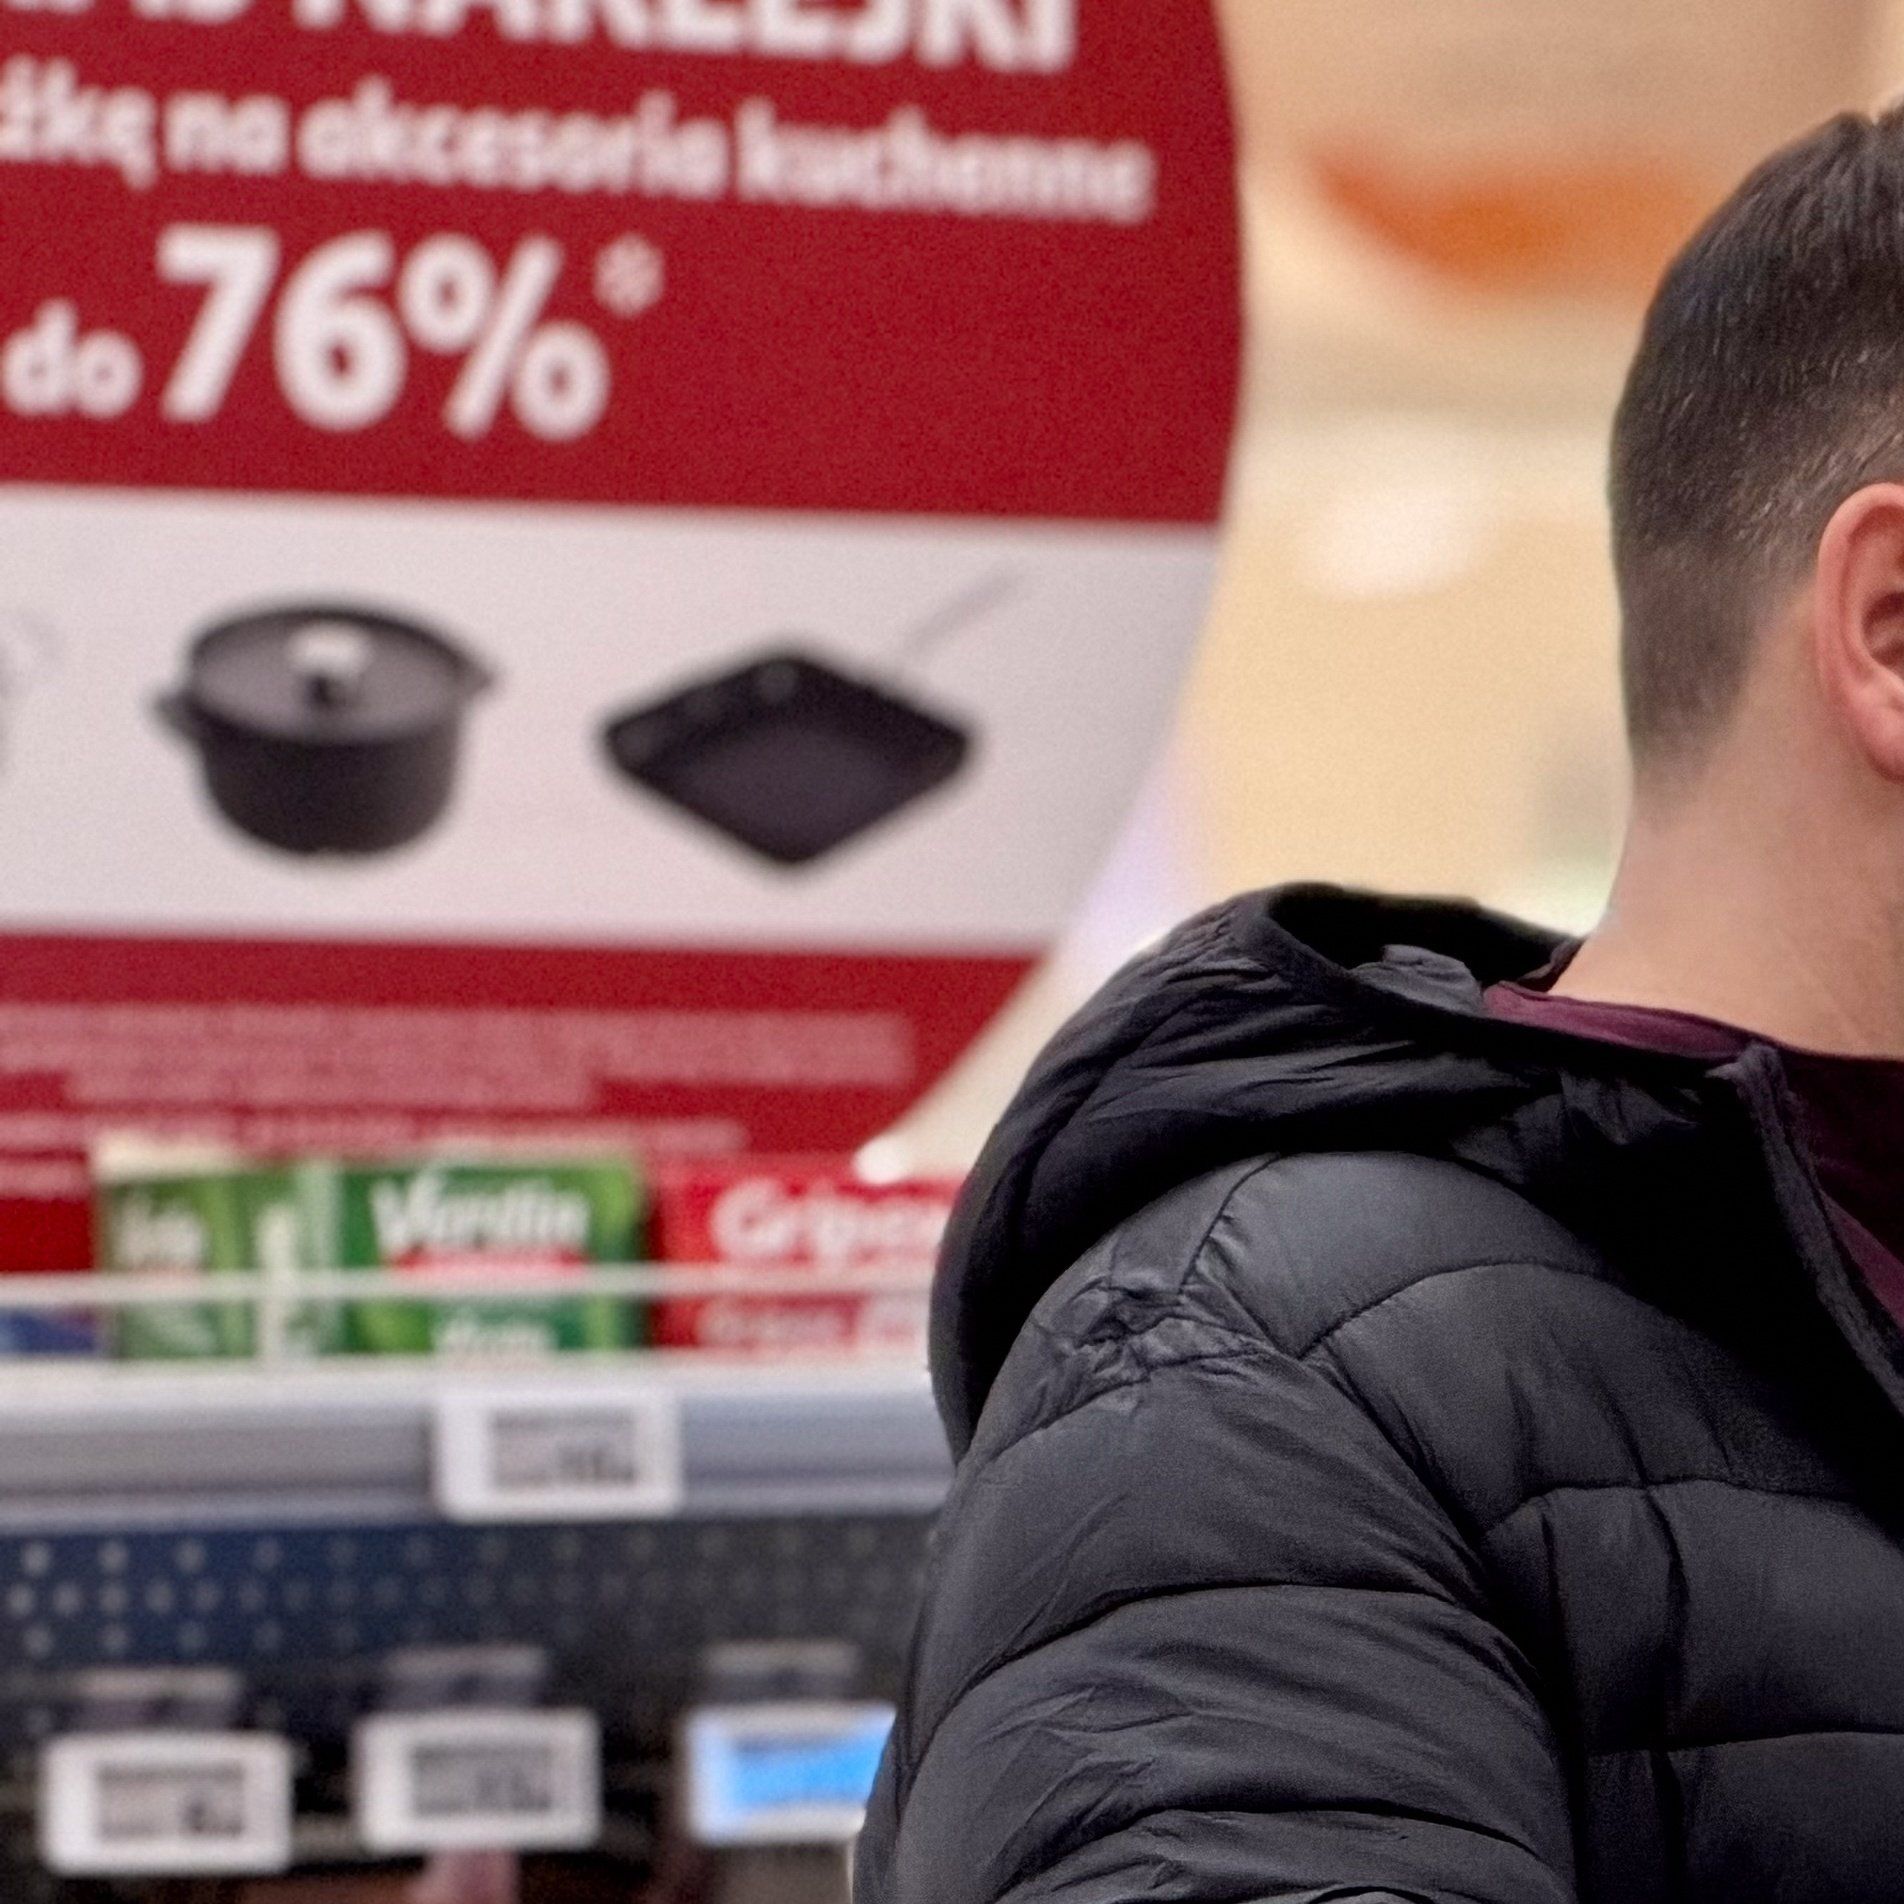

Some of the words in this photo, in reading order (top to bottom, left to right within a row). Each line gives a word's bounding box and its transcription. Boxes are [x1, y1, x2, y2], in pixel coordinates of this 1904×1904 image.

[163, 90, 290, 176] na
[297, 73, 728, 198] akcesoria
[2, 298, 140, 418] do
